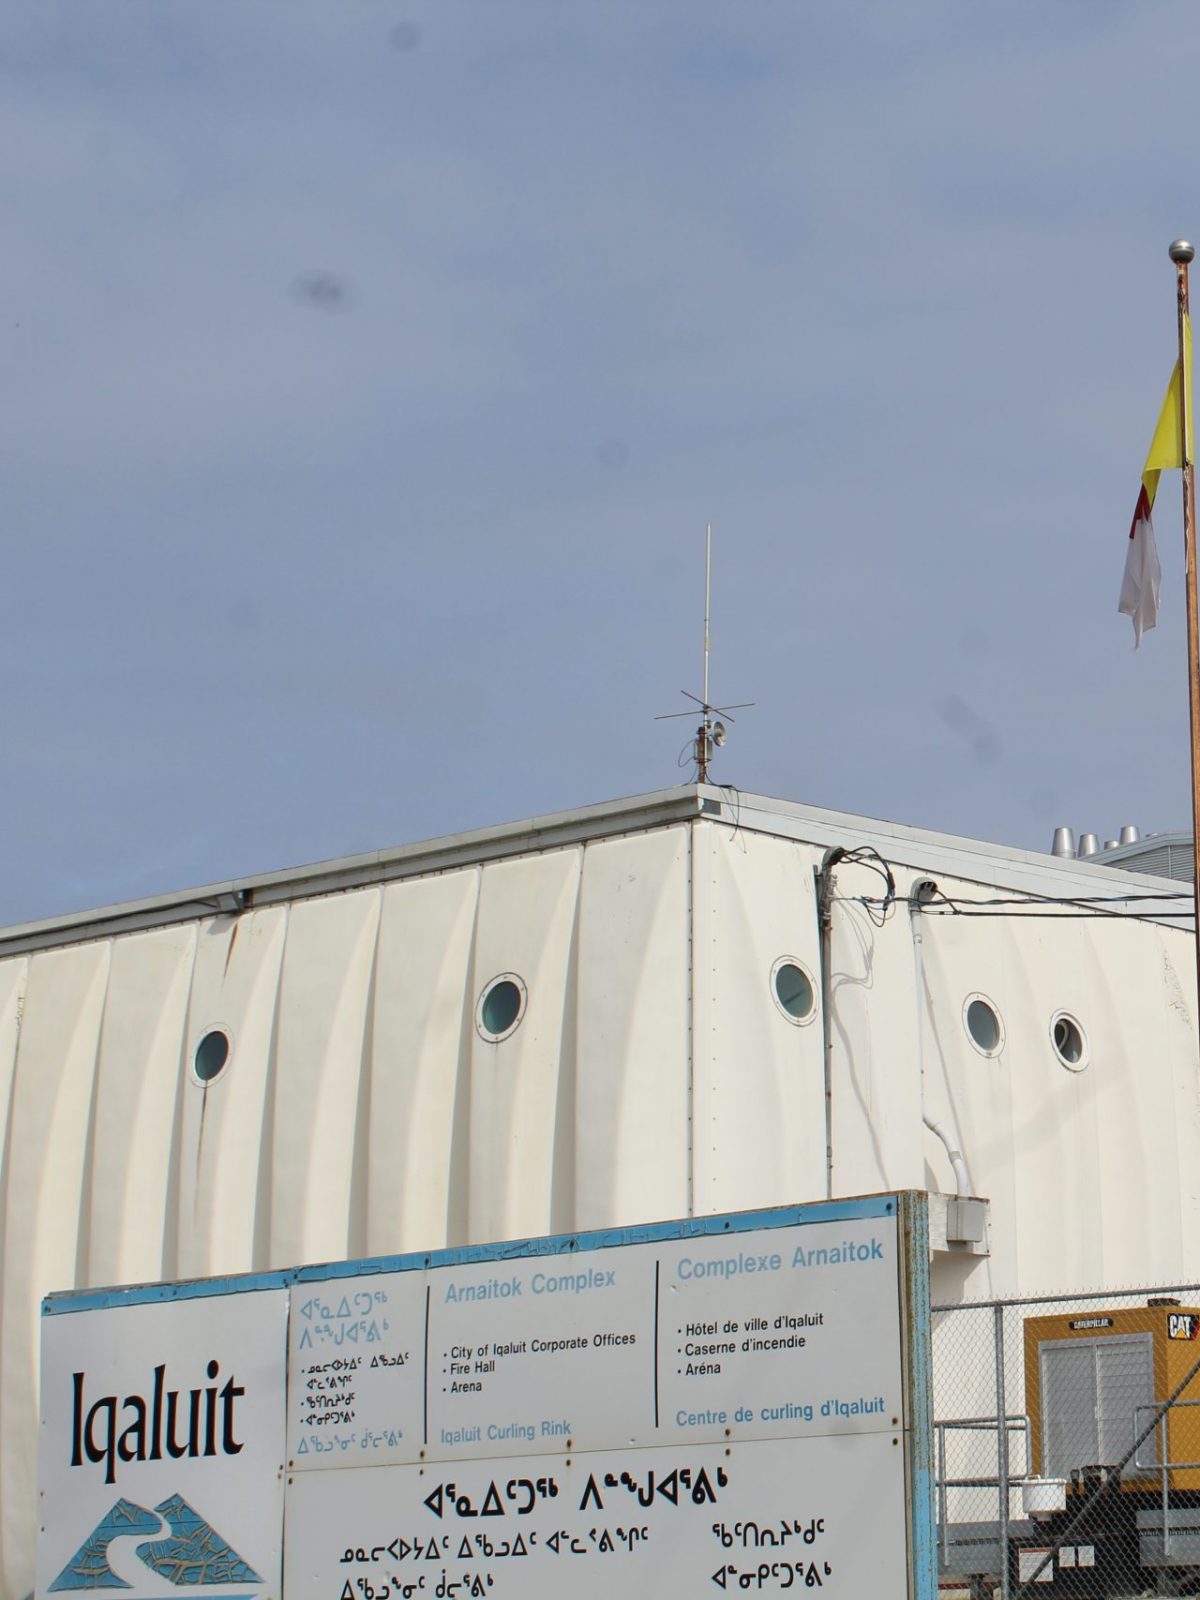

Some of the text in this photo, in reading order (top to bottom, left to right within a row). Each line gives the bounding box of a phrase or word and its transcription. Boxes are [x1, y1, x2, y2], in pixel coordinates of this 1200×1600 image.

[677, 1238, 884, 1281] Complexe Arnaitok
[445, 1268, 616, 1304] Arnaitok Complex
[685, 1312, 824, 1337] Hôtel de ville d'Iqaluit
[1073, 1318, 1110, 1329] CATERPILLAR
[1169, 1315, 1192, 1338] CAT
[451, 1332, 636, 1361] City of Iqaluit Corporate Offices
[684, 1334, 806, 1357] Caserne d'incendie
[450, 1360, 496, 1375] Fire Hall
[685, 1361, 721, 1376] Aréna
[450, 1380, 483, 1394] Arena
[71, 1359, 245, 1484] Iqaluit
[675, 1397, 885, 1427] Centre de curling d'Iqaluit
[440, 1419, 571, 1446] Iqaluit Curling Rink
